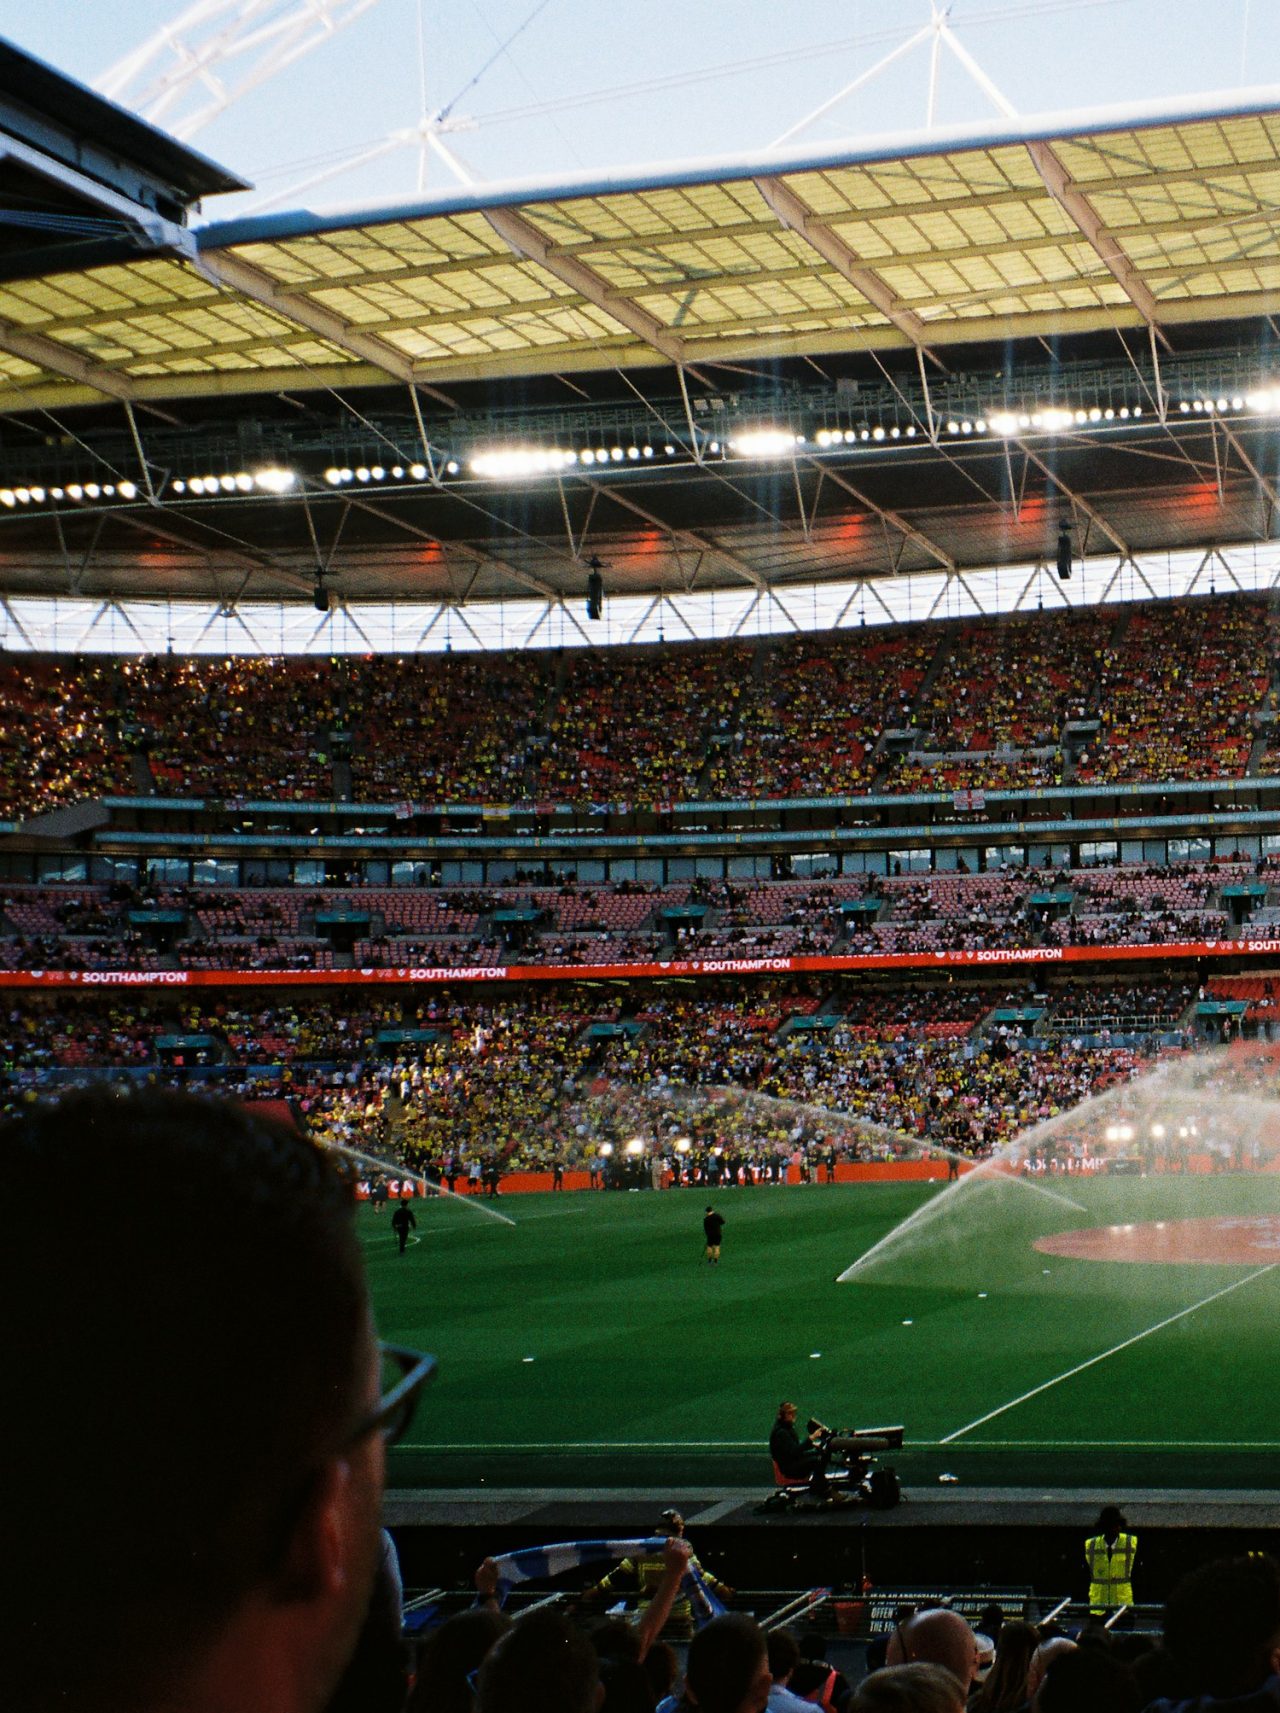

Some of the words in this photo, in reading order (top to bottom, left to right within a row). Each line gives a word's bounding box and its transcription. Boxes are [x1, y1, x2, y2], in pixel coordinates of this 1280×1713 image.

[977, 949, 1062, 961] SOUTHAMPTON
[703, 959, 790, 971] SOUTHAMPTON
[82, 972, 187, 983] SOUTHAMPTON
[410, 968, 506, 979] SOUTHAMPTON
